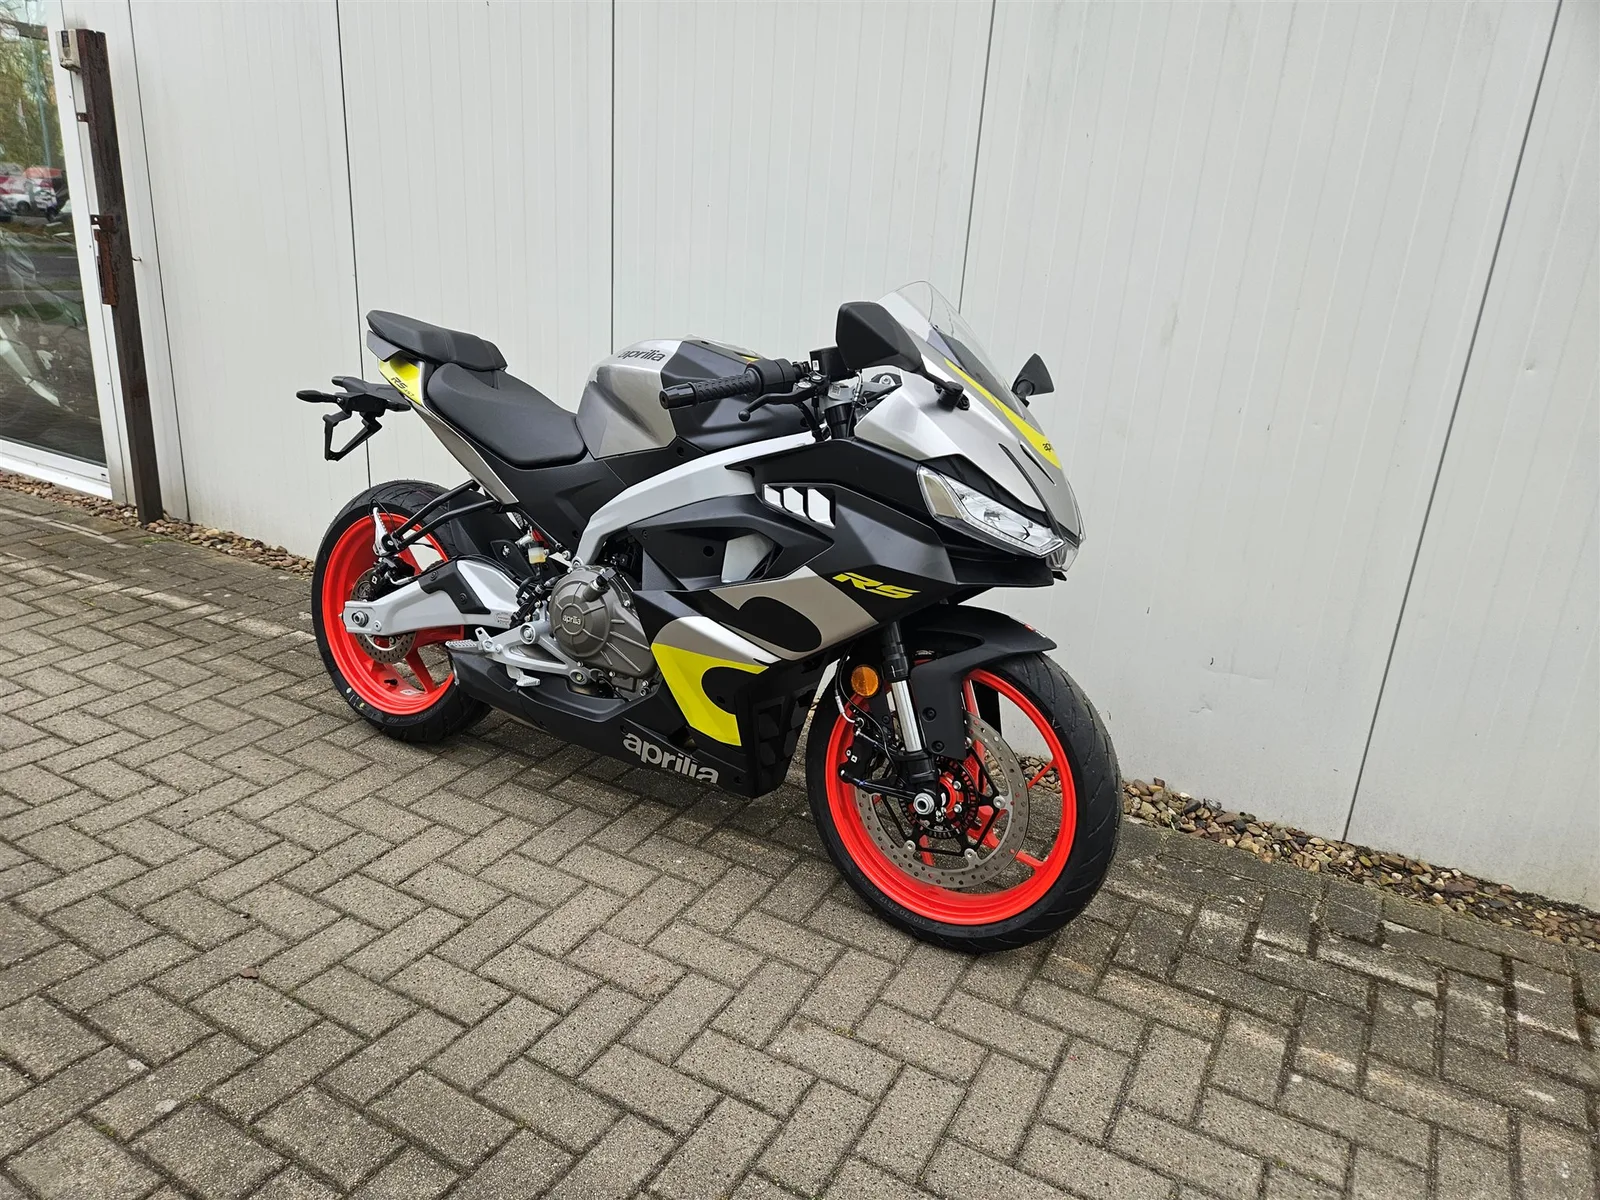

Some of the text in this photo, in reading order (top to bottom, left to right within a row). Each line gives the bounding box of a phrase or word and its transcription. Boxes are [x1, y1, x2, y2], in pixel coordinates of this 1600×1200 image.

[617, 349, 666, 362] aprilia
[390, 376, 408, 390] RS
[832, 572, 922, 599] RS
[562, 614, 581, 626] aprilia
[622, 732, 719, 784] aprilia
